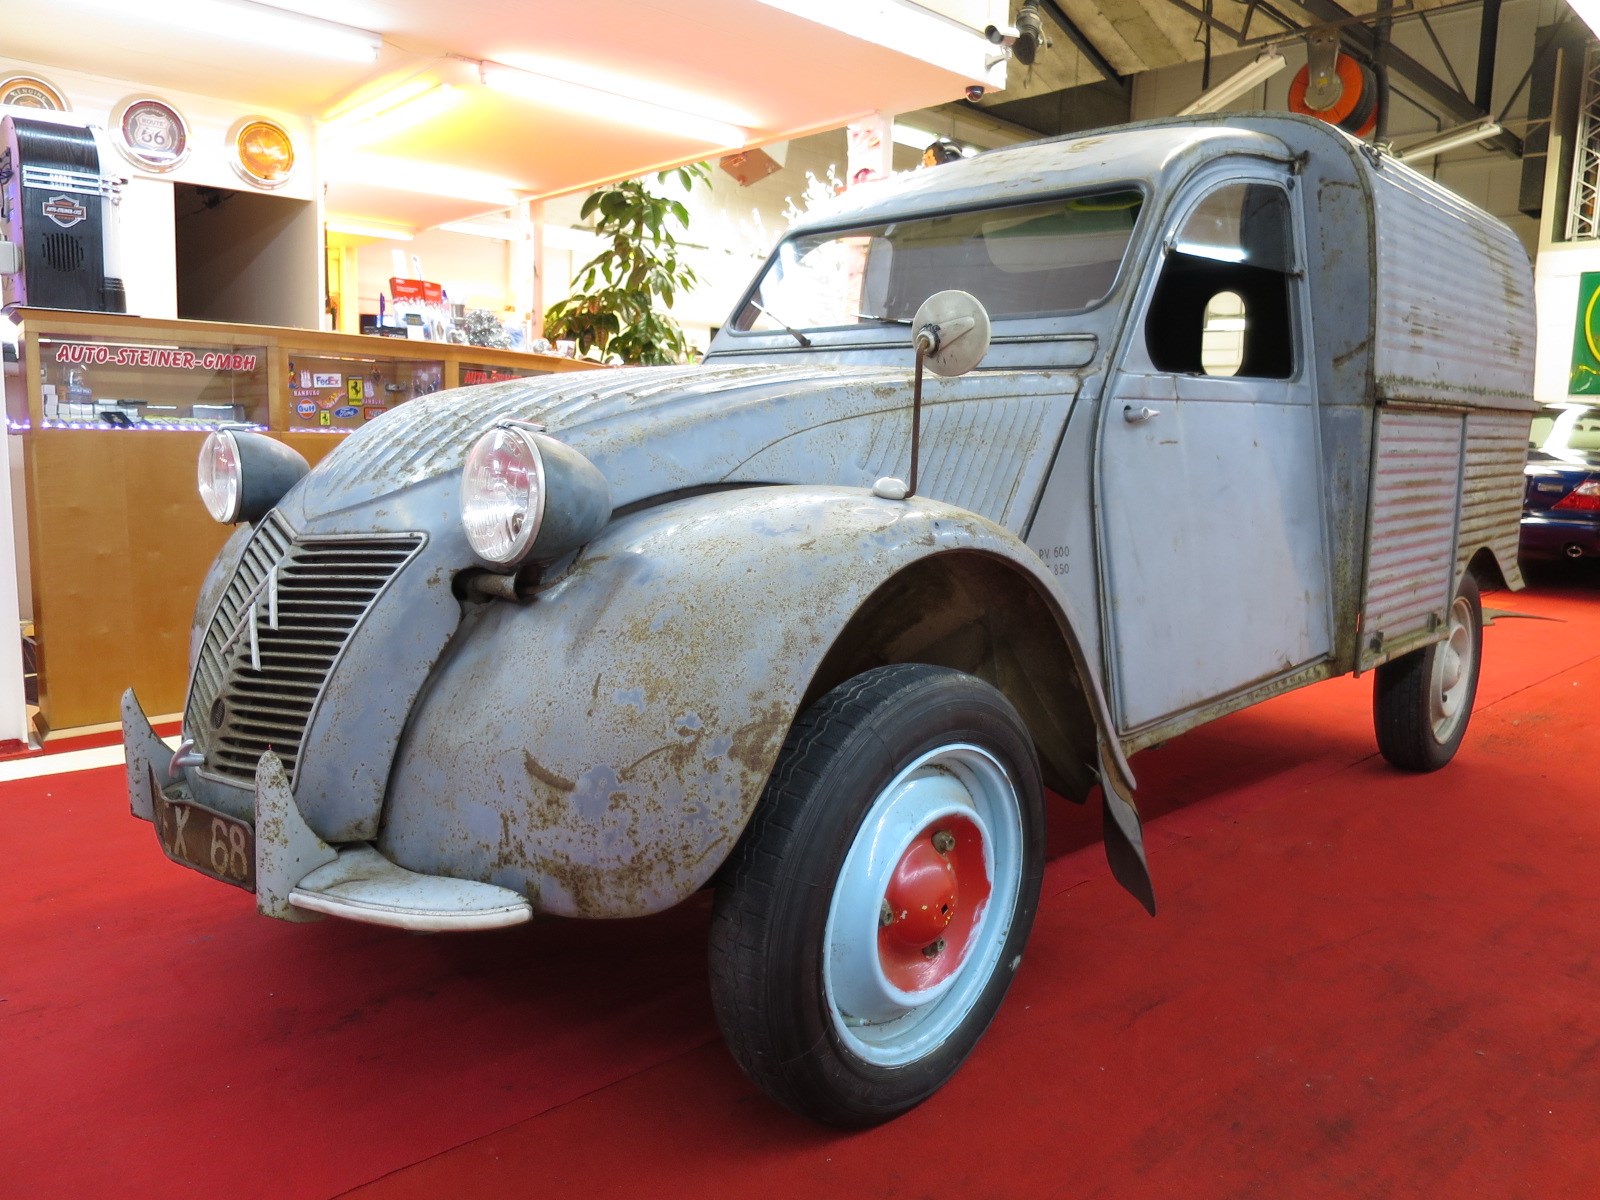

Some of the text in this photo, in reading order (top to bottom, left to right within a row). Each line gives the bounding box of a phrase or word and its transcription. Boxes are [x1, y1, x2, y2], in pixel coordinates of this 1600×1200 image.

[13, 88, 47, 102] GENUINE
[141, 117, 165, 127] ROUTE
[141, 127, 165, 145] 66
[56, 344, 257, 371] AUTO-STEINER-GMBH
[316, 376, 339, 386] FedEx
[1053, 546, 1070, 558] 600
[1053, 563, 1070, 576] 850
[210, 818, 248, 880] 68
